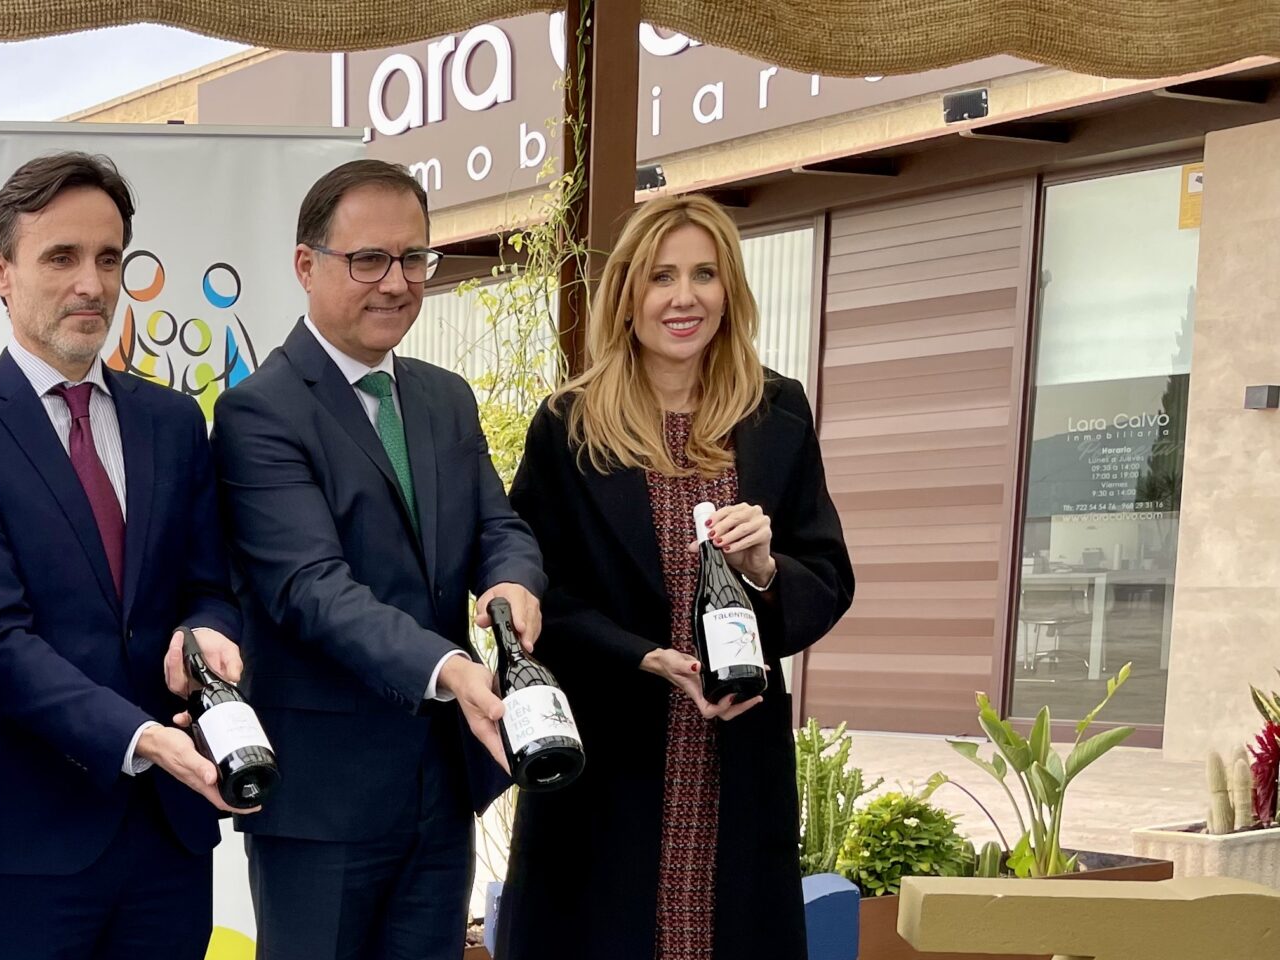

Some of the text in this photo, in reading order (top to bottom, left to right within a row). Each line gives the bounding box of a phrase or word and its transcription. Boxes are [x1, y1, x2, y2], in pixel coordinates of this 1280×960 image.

[331, 24, 512, 143] Lara
[1068, 412, 1170, 432] Lara Calvo
[1066, 429, 1169, 442] inmobiliaria
[1102, 446, 1132, 454] Horario
